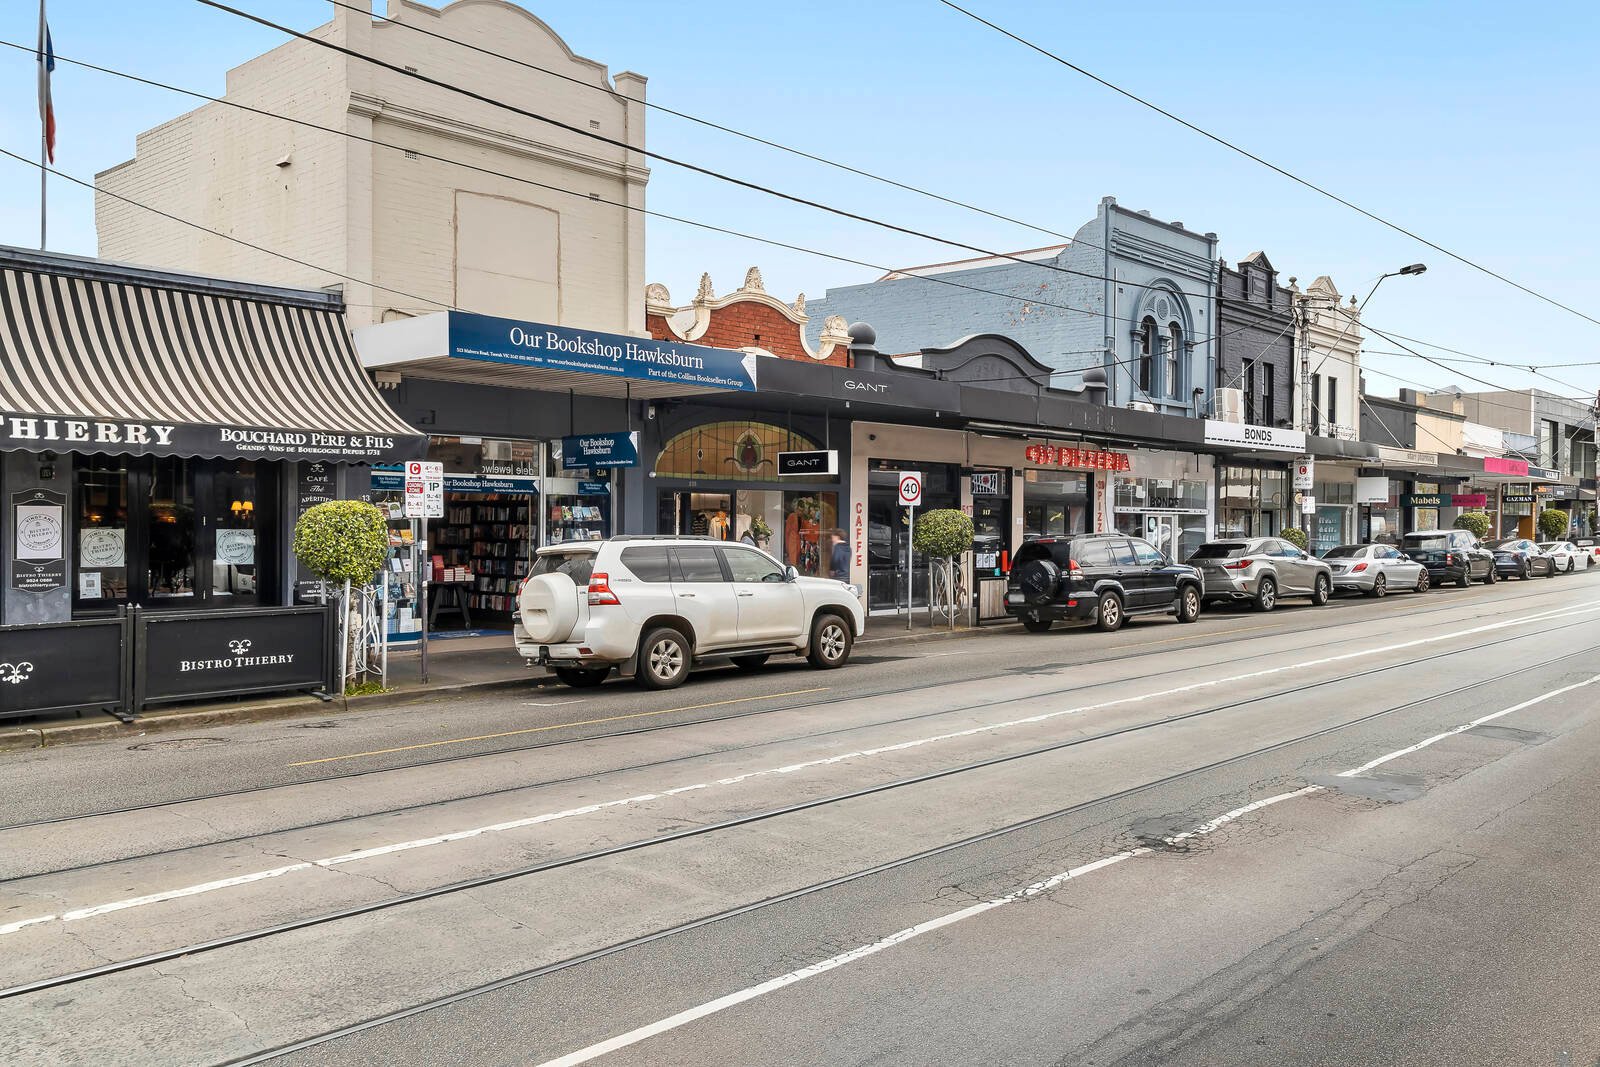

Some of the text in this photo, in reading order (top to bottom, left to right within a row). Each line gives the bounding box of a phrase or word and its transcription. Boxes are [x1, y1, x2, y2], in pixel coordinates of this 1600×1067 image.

[509, 326, 704, 370] Our Bookshop Hawksburn
[648, 368, 744, 388] Part of the Collins Booksellers Group
[844, 380, 888, 393] GANT
[220, 428, 394, 449] BOUCHARD PÈRE & FILS
[1244, 428, 1272, 442] BONDS
[580, 437, 615, 448] Our Bookshop
[236, 443, 266, 452] GRANDS
[268, 444, 285, 452] VINS
[298, 446, 342, 455] BOURGOGNE
[583, 446, 612, 456] Hawksburn
[786, 458, 820, 468] GANT
[1057, 446, 1131, 472] PIZZERIA
[429, 482, 440, 492] 1P
[452, 479, 482, 488] Bookshop
[482, 480, 514, 488] Hawksburn
[903, 483, 918, 495] 40
[1150, 496, 1180, 508] BONDS
[1410, 496, 1441, 505] Mabels
[180, 654, 294, 672] BISTRO THIERRY
